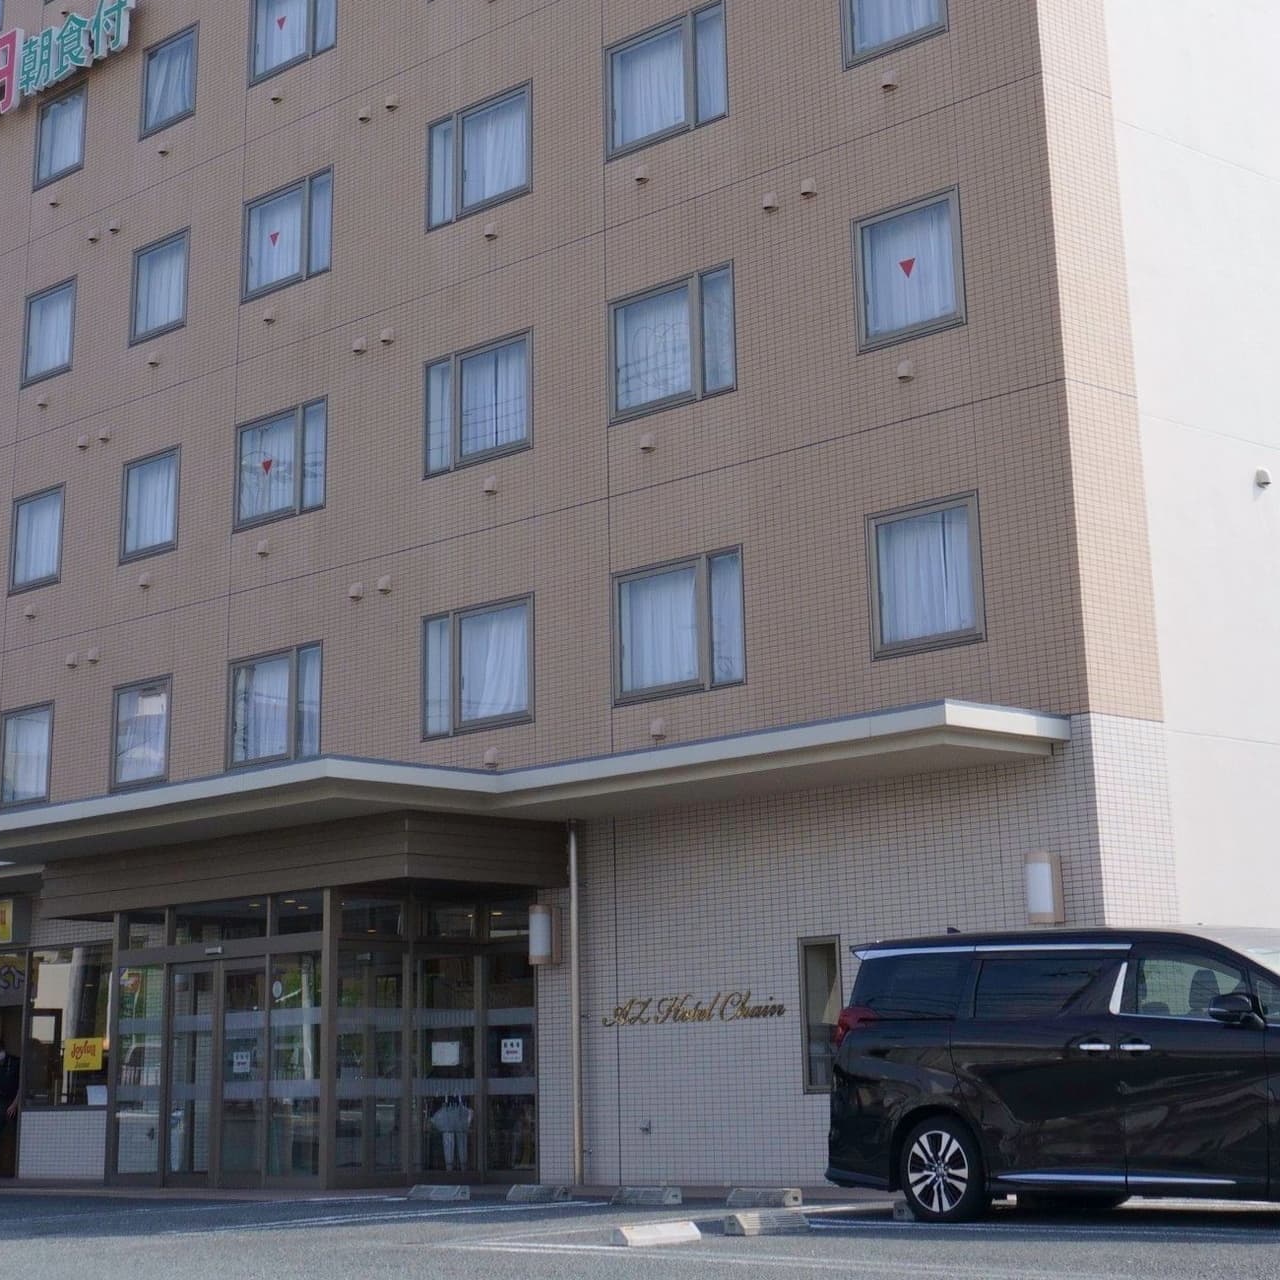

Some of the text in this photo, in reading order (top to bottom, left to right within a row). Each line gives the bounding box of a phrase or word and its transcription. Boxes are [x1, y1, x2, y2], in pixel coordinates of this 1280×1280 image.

[602, 991, 786, 1027] AZ Hotel Chain
